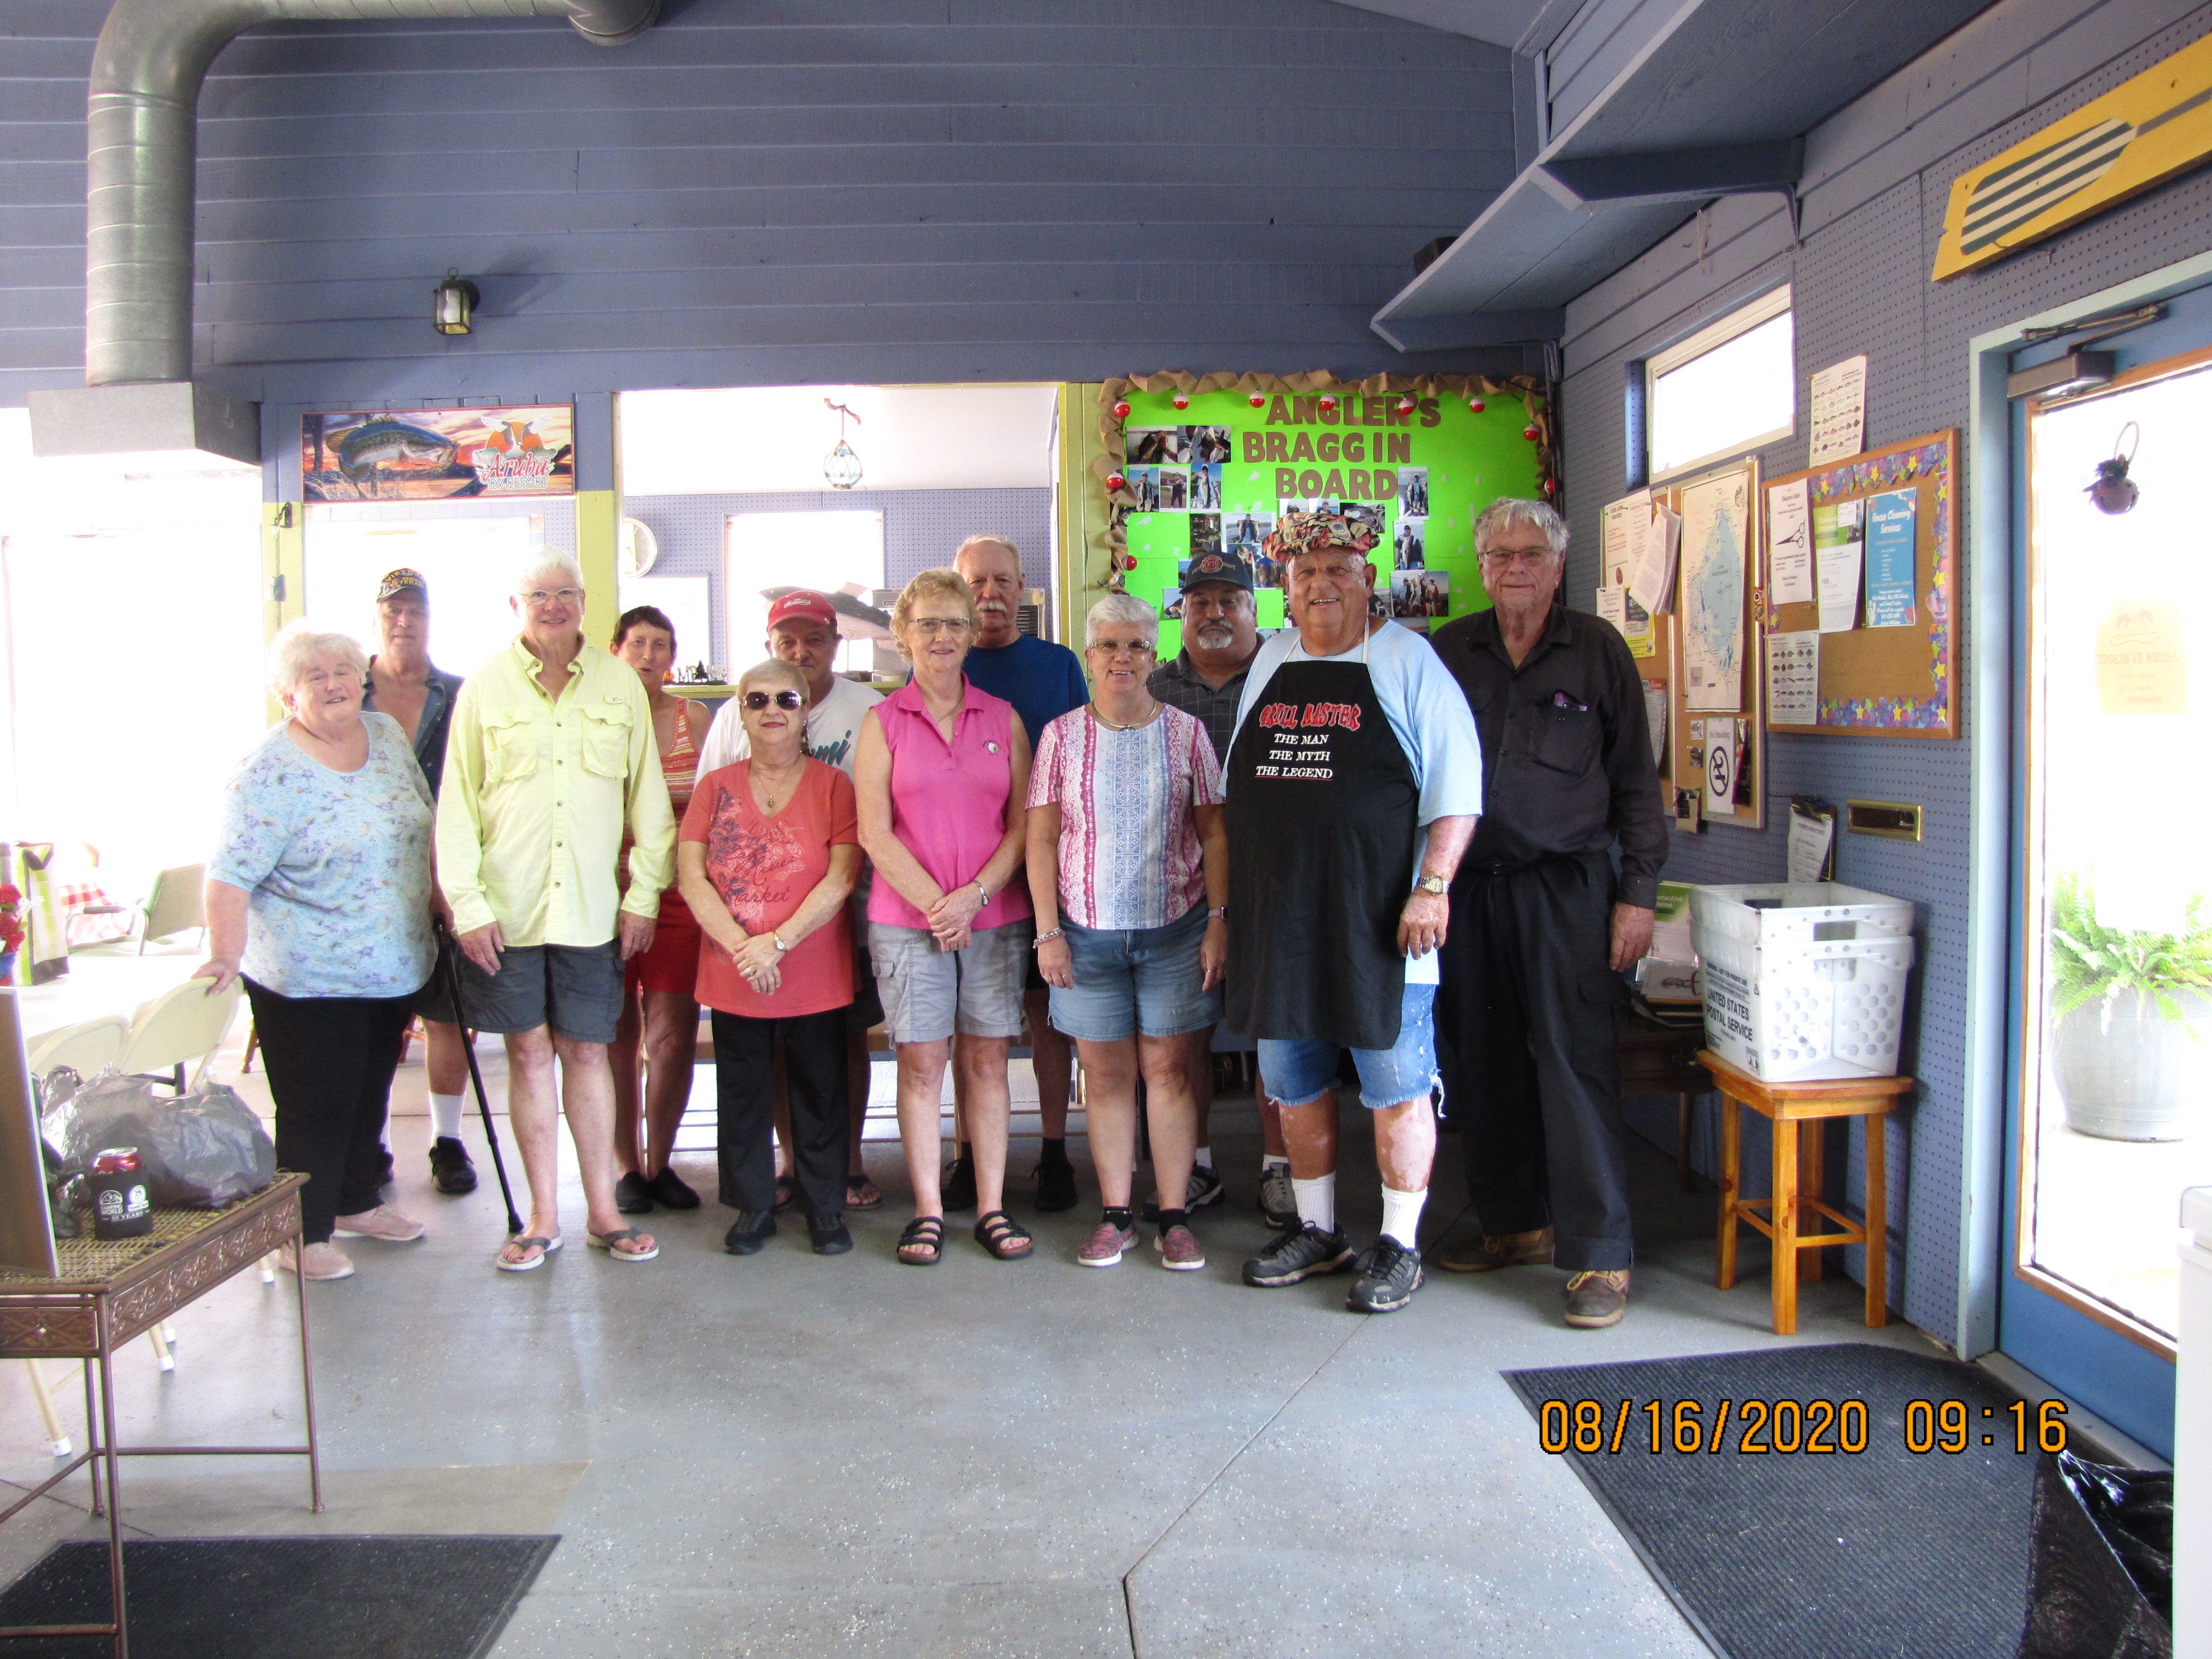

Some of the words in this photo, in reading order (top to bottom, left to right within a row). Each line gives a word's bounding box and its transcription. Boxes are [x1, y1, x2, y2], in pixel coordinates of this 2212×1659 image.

[1266, 395, 1441, 427] ANGLER'S
[482, 452, 549, 481] Aruba
[489, 477, 504, 489] RV
[507, 476, 548, 488] RESORT
[1276, 468, 1398, 500] BOARD
[1888, 510, 1910, 520] Cleaning
[1880, 523, 1901, 534] Services
[1259, 702, 1298, 728] GRILL
[1301, 702, 1361, 731] MASTER
[1274, 733, 1298, 745] THE
[1300, 734, 1329, 745] MAN
[1269, 750, 1293, 761] THE
[1296, 750, 1331, 761] MYTH
[1255, 765, 1279, 776] THE
[1281, 766, 1333, 779] LEGEND
[1707, 987, 1726, 1008] UNITED
[1726, 997, 1750, 1021] STATES
[1707, 1003, 1726, 1027] POSTAL
[1727, 1016, 1753, 1041] SERVICE
